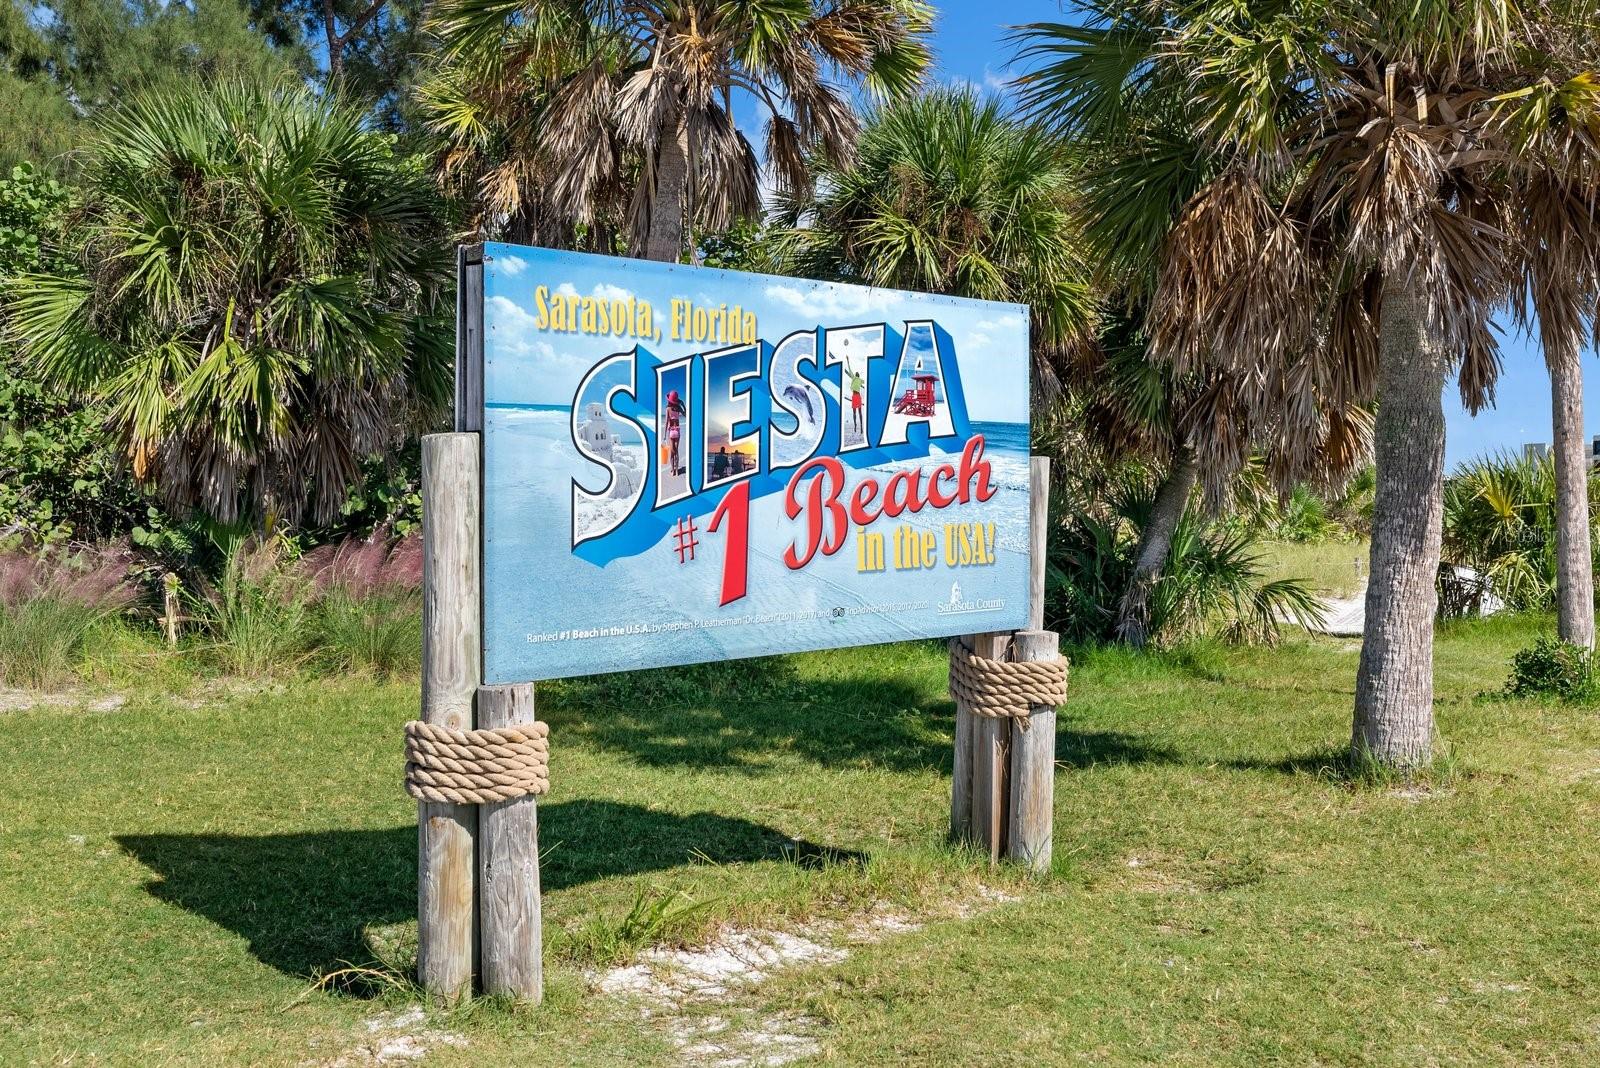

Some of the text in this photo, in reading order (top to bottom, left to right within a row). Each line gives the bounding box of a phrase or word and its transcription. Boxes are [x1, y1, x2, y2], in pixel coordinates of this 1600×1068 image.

[534, 285, 757, 347] Sarasota, Florida
[571, 319, 974, 565] SIESTA
[783, 434, 999, 570] Beach
[856, 520, 997, 573] in the USA!
[526, 631, 558, 643] Ranked
[559, 630, 571, 641] #1
[573, 627, 599, 640] Beach
[600, 626, 609, 638] in
[610, 625, 625, 636] the
[626, 623, 651, 635] U.S.A.
[653, 623, 662, 634] by
[663, 620, 693, 632] Stephen
[701, 616, 742, 628] Leatherman
[818, 607, 830, 618] and
[937, 597, 1006, 613] Sarasota County
